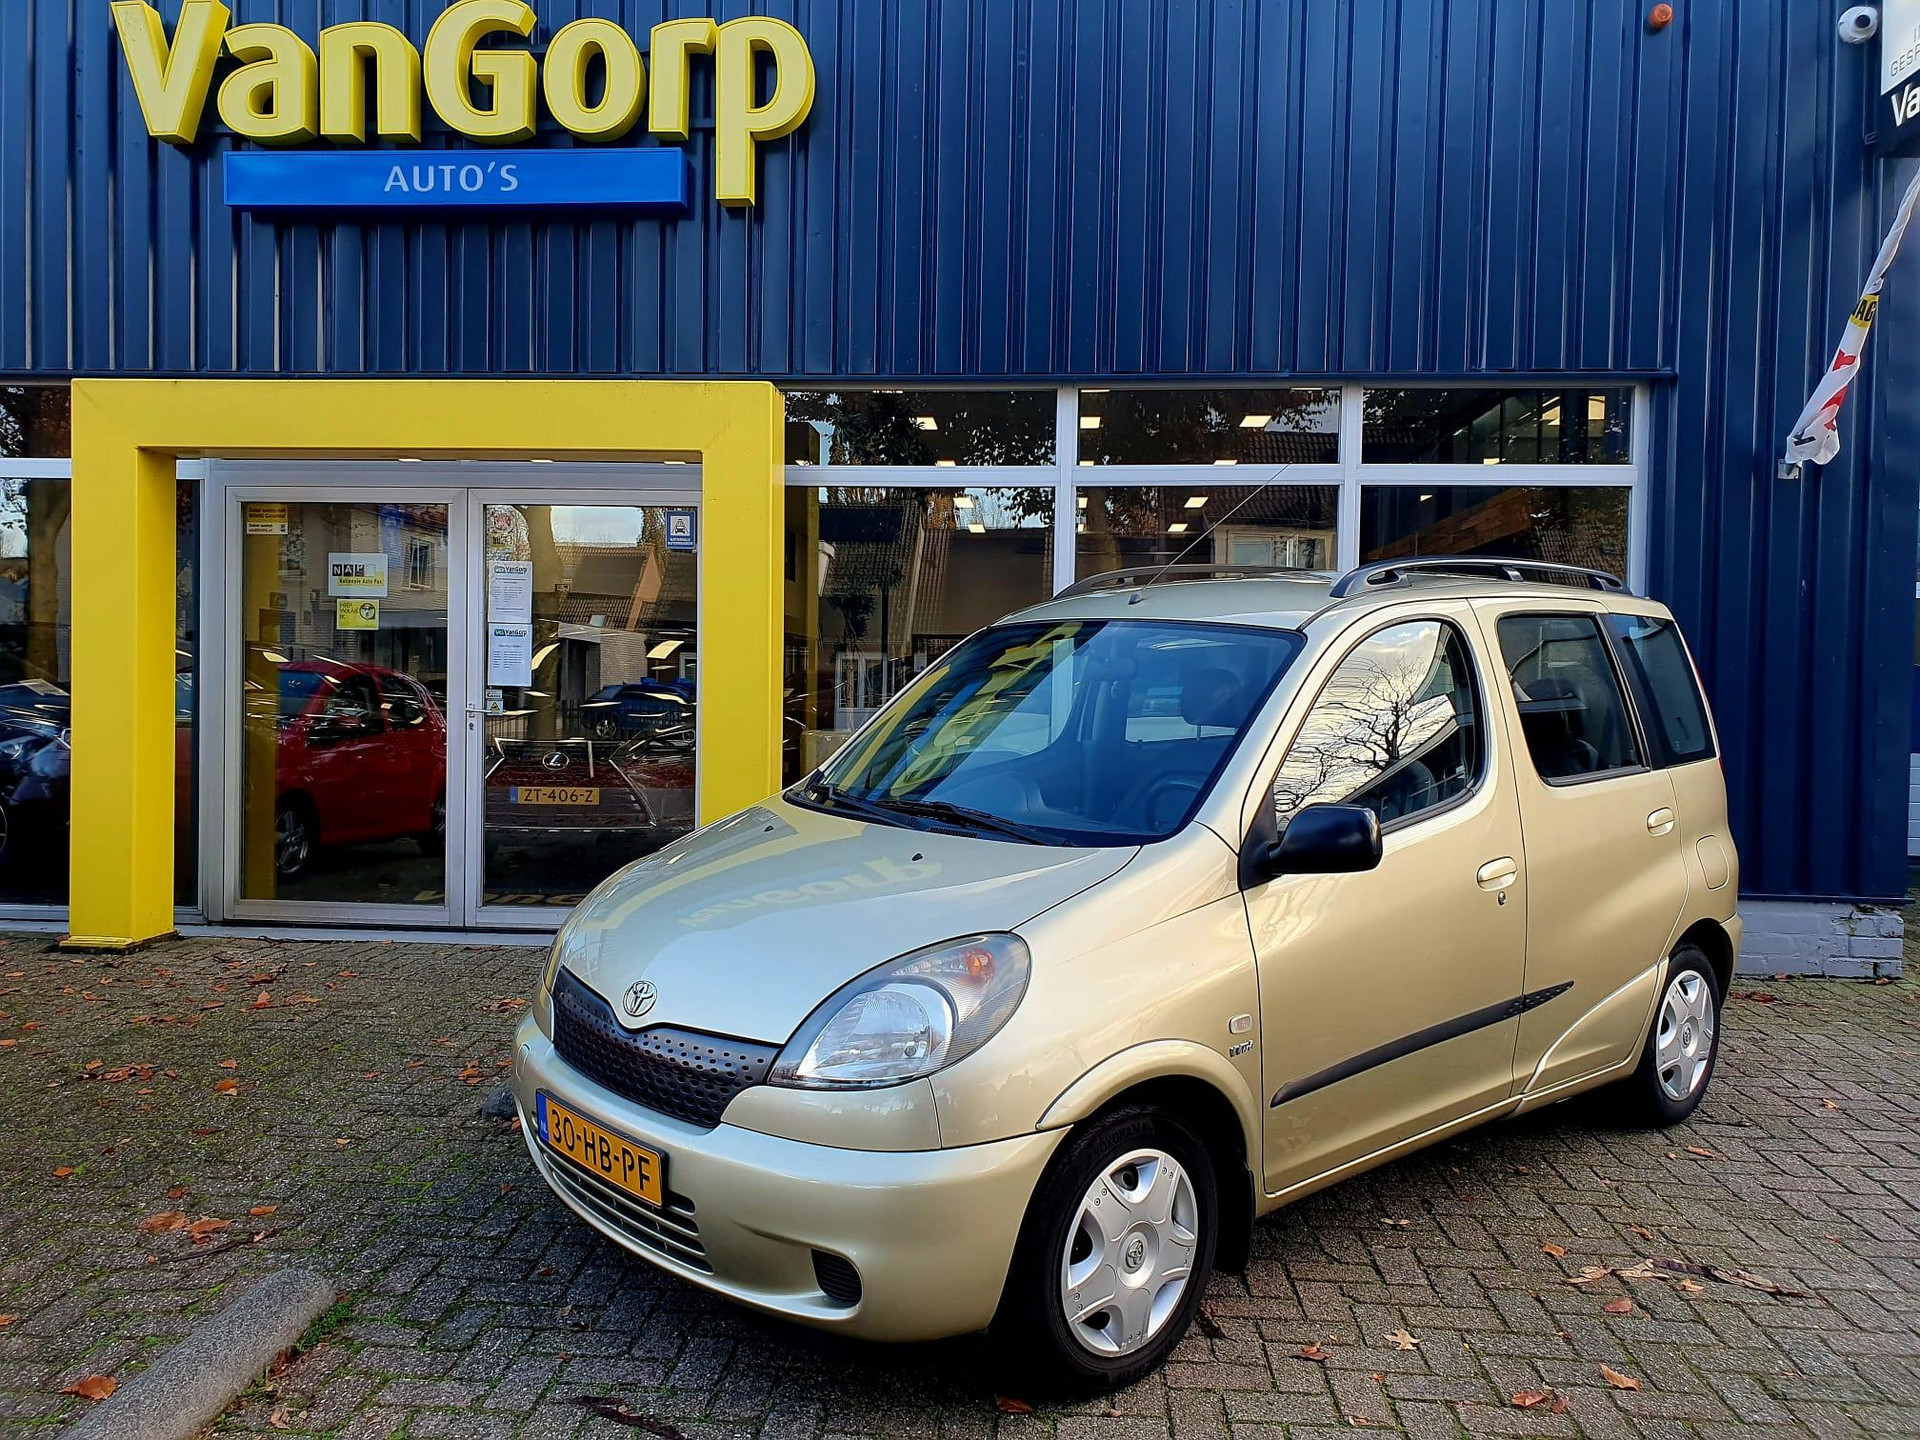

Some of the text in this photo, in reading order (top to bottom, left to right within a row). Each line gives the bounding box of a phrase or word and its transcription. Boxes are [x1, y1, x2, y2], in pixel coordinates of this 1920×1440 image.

[111, 0, 816, 207] VanGorp
[383, 160, 519, 193] AUTO'S
[524, 788, 594, 803] ZT-406-Z
[551, 1107, 651, 1192] 30-HB-PF
